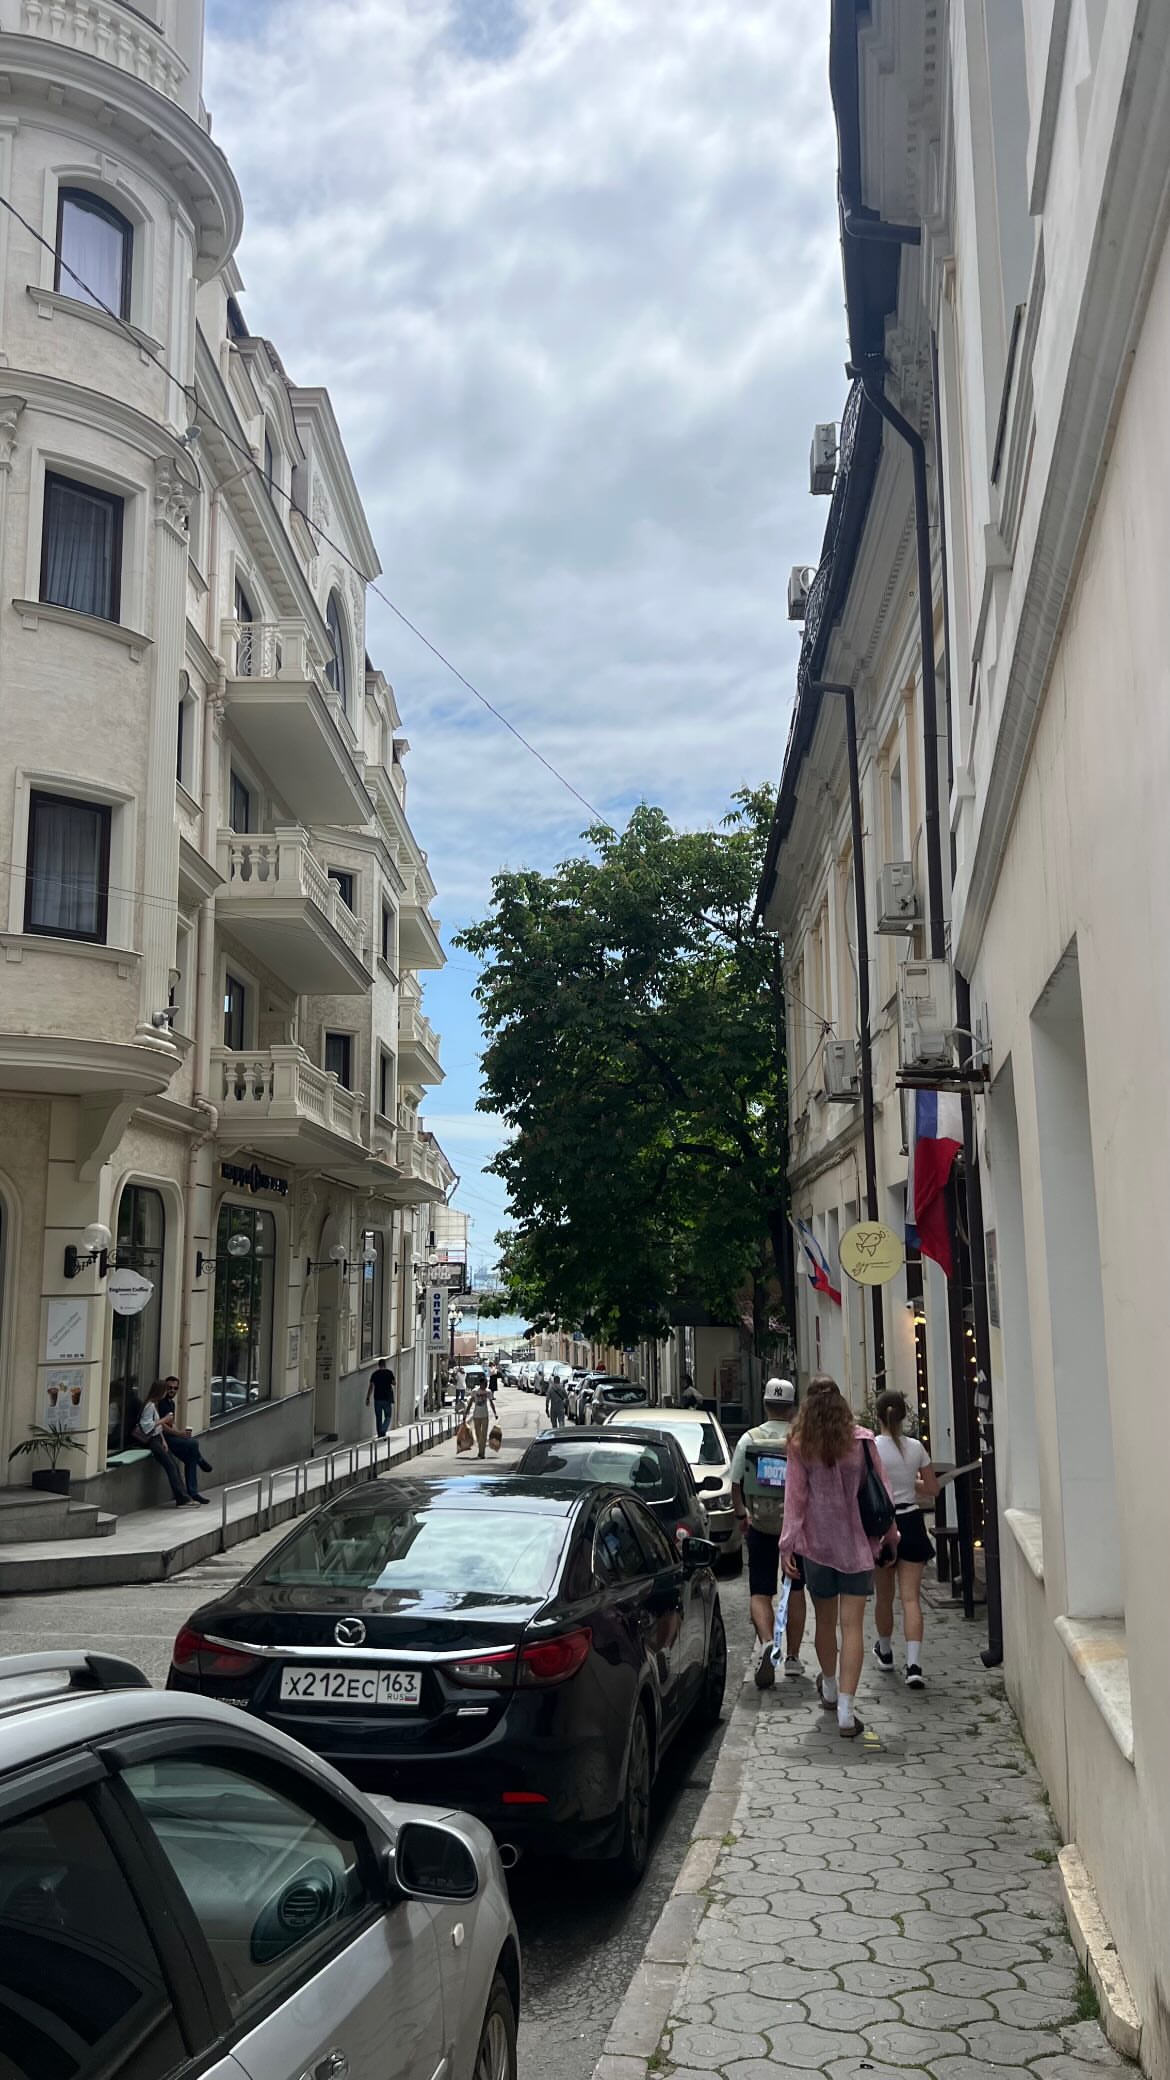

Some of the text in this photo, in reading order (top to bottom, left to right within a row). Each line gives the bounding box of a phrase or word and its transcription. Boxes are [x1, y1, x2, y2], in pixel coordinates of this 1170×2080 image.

[433, 1293, 441, 1340] ОПТИКА
[382, 1673, 415, 1693] 163
[387, 1693, 408, 1701] RUS
